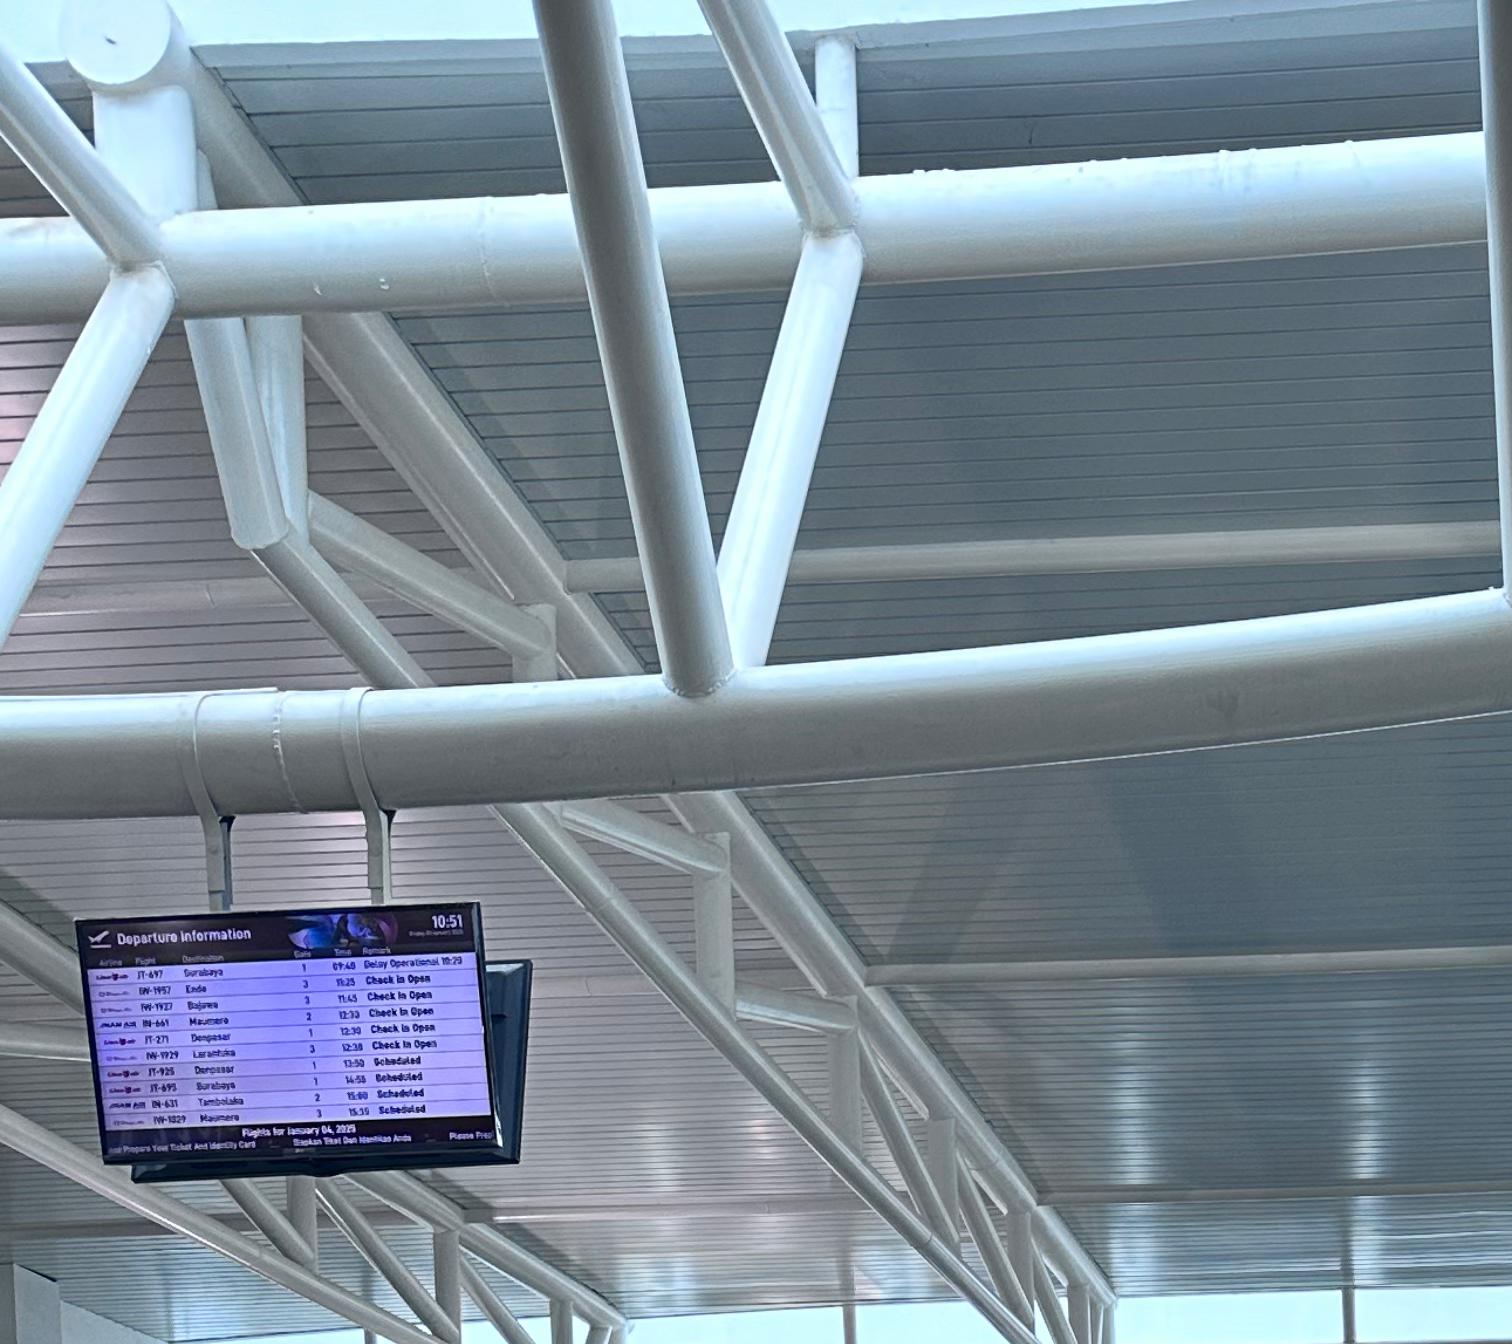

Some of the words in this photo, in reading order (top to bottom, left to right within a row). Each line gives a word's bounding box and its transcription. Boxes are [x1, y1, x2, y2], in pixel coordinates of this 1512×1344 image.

[431, 914, 463, 929] 10:51
[116, 930, 177, 945] Departure
[365, 975, 394, 985] Check
[407, 974, 431, 985] Open
[367, 992, 396, 1001] Check
[409, 991, 432, 1001] Open
[368, 1008, 398, 1018] Check
[410, 1007, 434, 1017] Open
[370, 1024, 399, 1034] Check
[412, 1023, 436, 1034] Open
[372, 1040, 401, 1050] Check
[414, 1040, 437, 1050] Open
[373, 1056, 421, 1066] Scheduled
[375, 1072, 423, 1083] Scheduled
[377, 1088, 424, 1099] Scheduled
[378, 1105, 426, 1115] Scheduled
